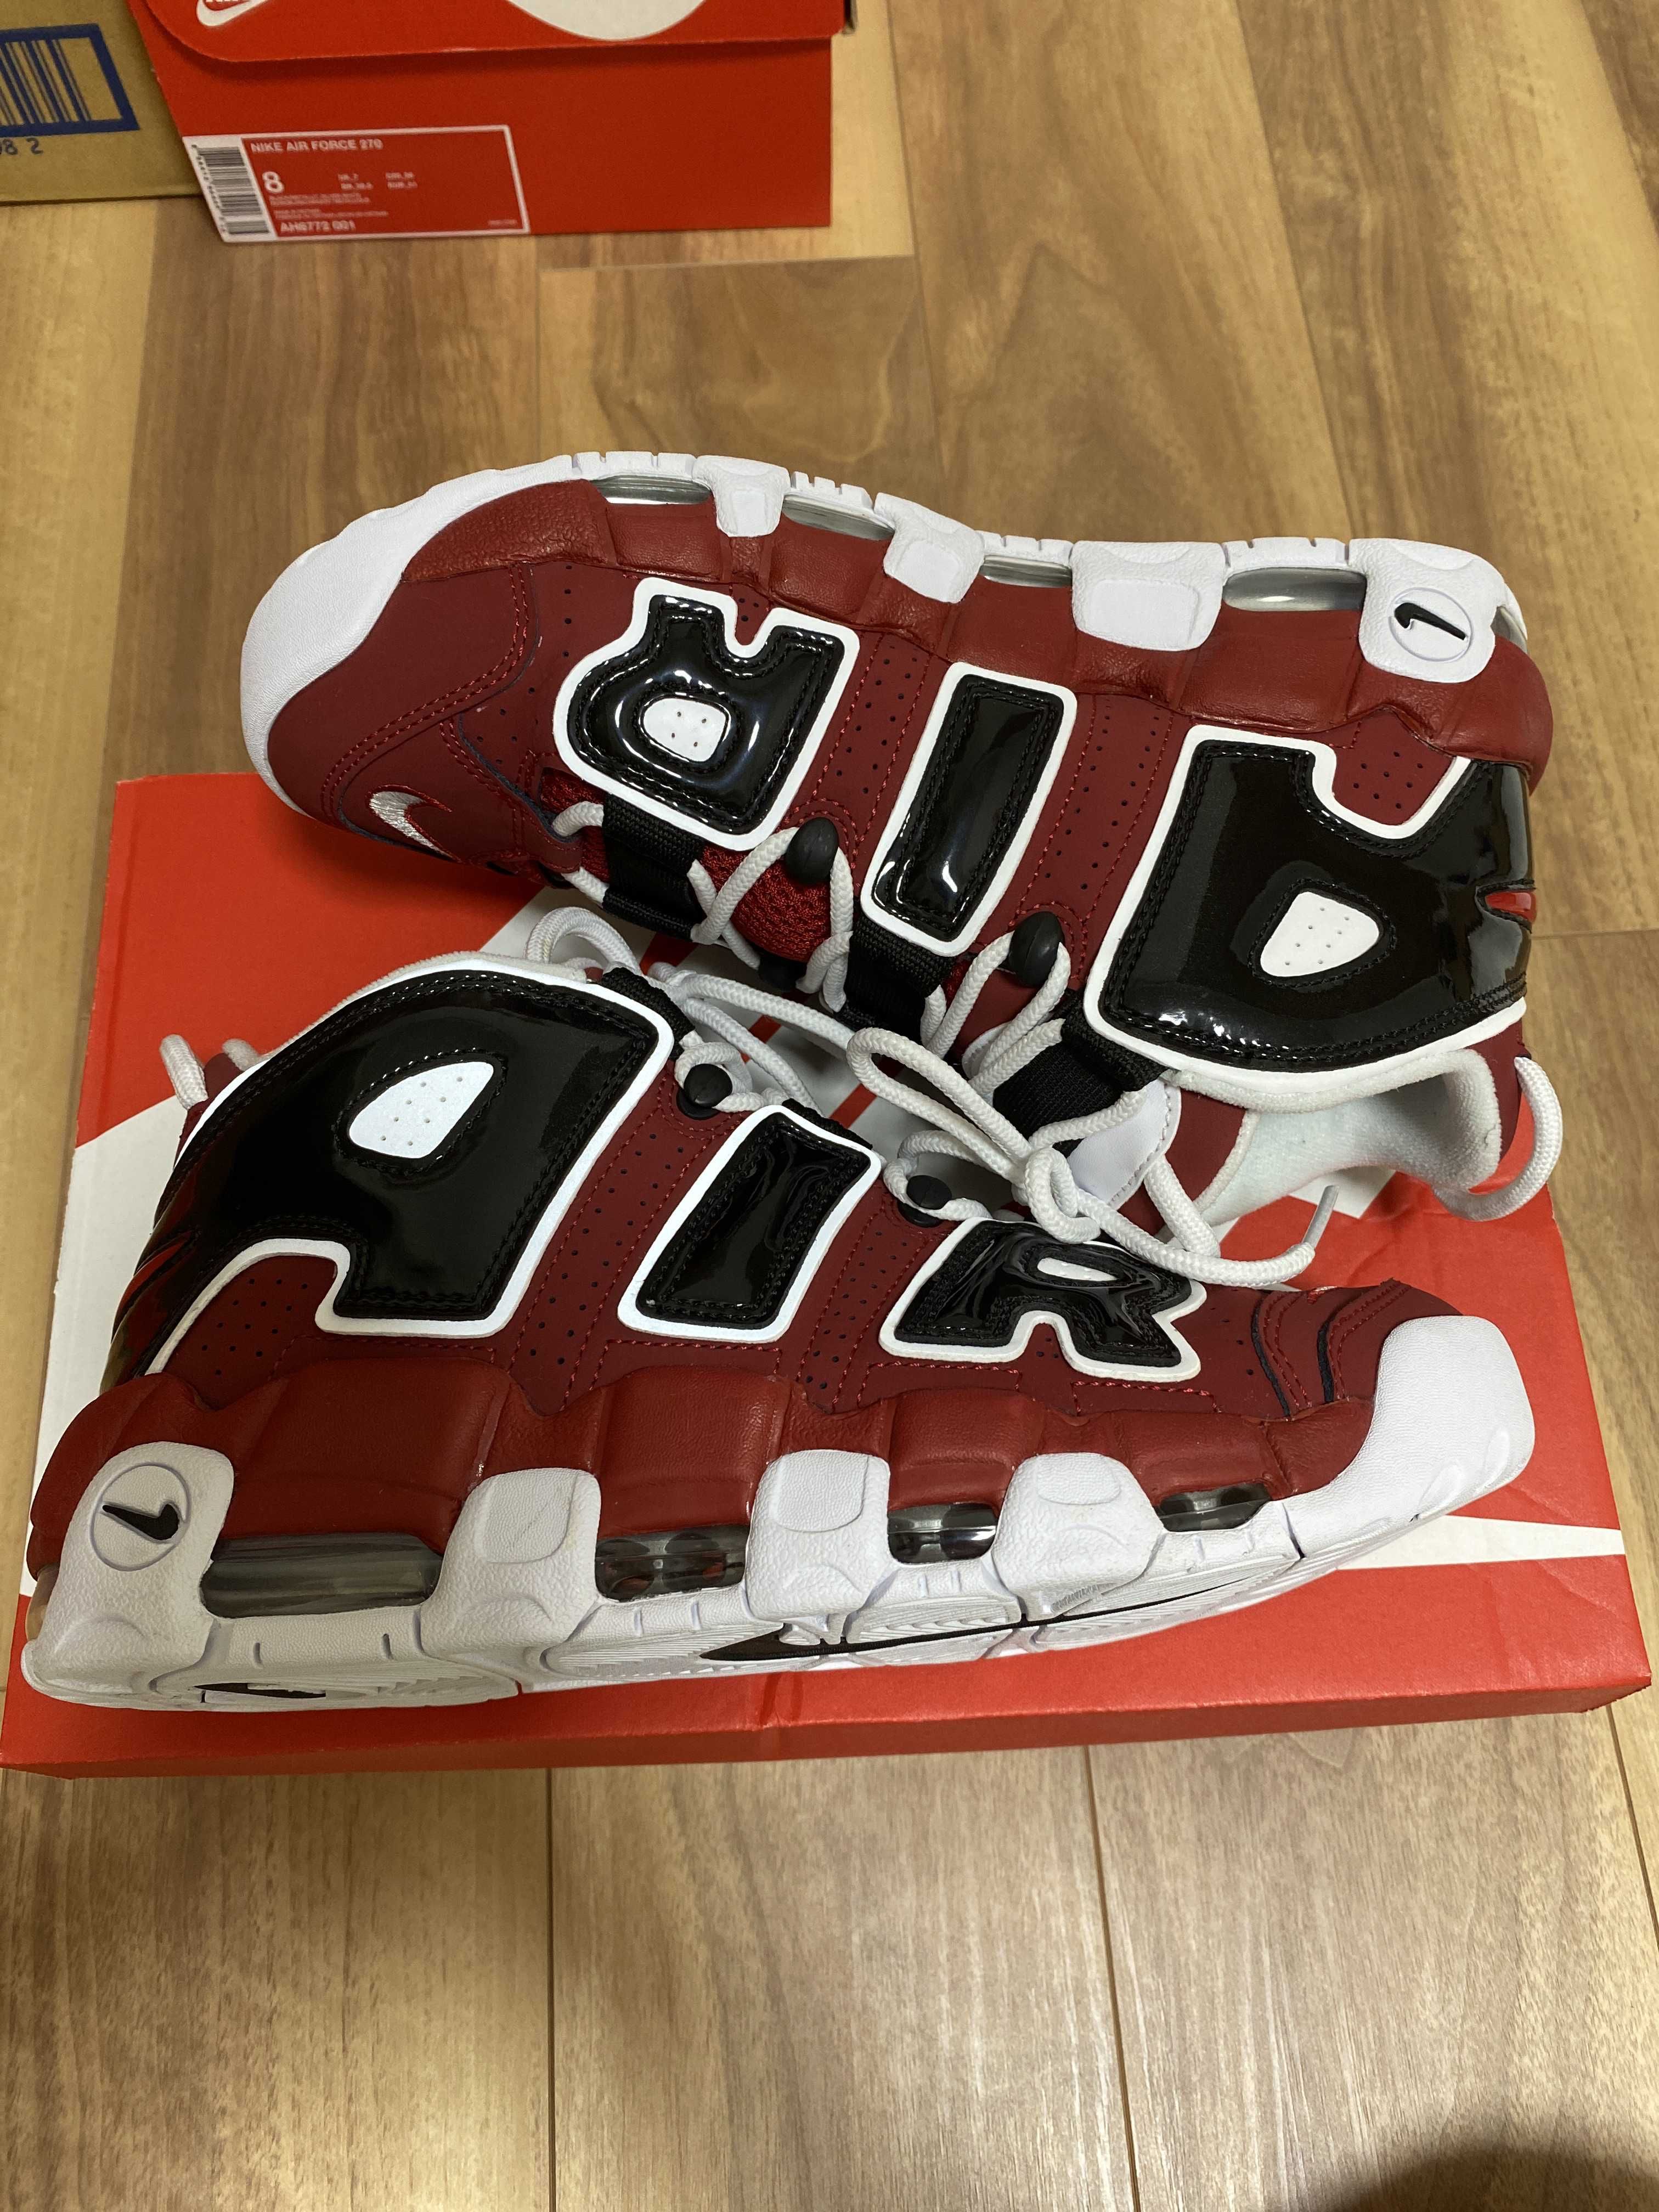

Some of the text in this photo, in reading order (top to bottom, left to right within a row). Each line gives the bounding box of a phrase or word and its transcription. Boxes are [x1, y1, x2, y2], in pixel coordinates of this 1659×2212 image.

[26, 137, 44, 155] 2
[250, 142, 283, 153] NIKE
[286, 140, 309, 151] AIR
[311, 139, 357, 151] FORCE
[262, 171, 285, 193] 8
